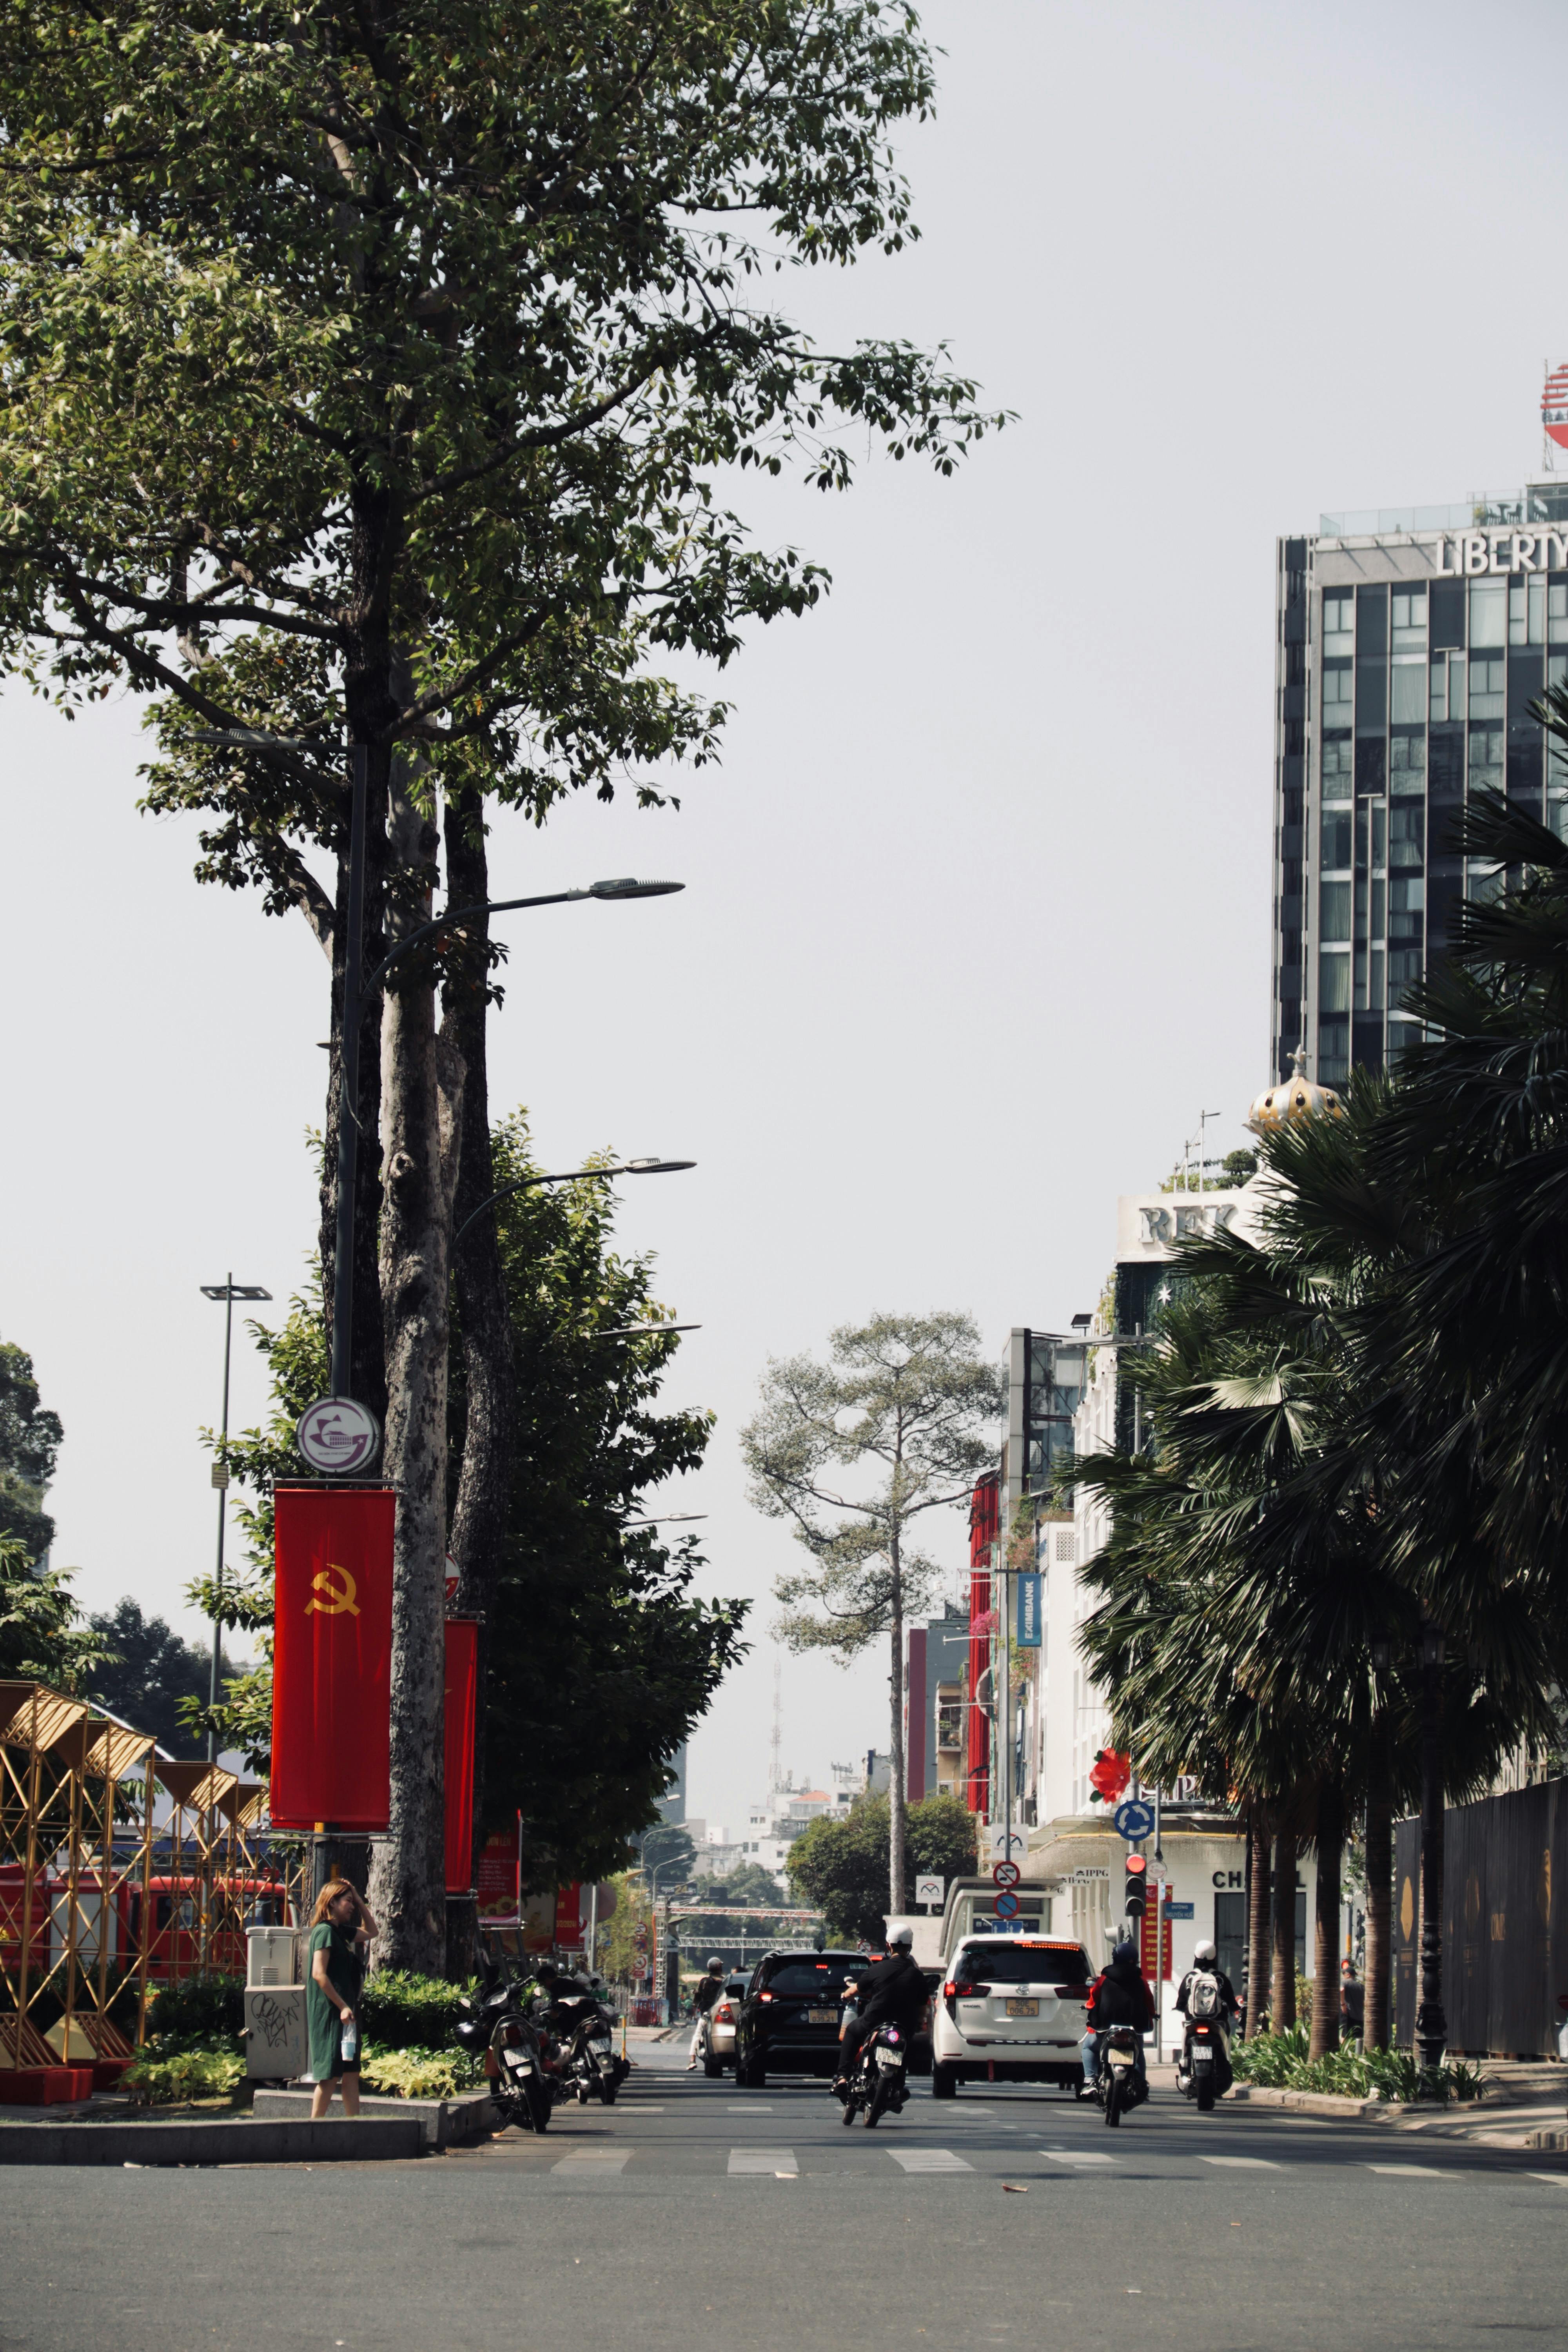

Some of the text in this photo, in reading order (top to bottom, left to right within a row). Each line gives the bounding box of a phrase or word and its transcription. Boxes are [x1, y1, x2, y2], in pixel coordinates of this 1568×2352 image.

[1436, 531, 1568, 575] LIBERTY
[1139, 1204, 1236, 1243] REX
[1025, 1581, 1034, 1639] EXIMBANK
